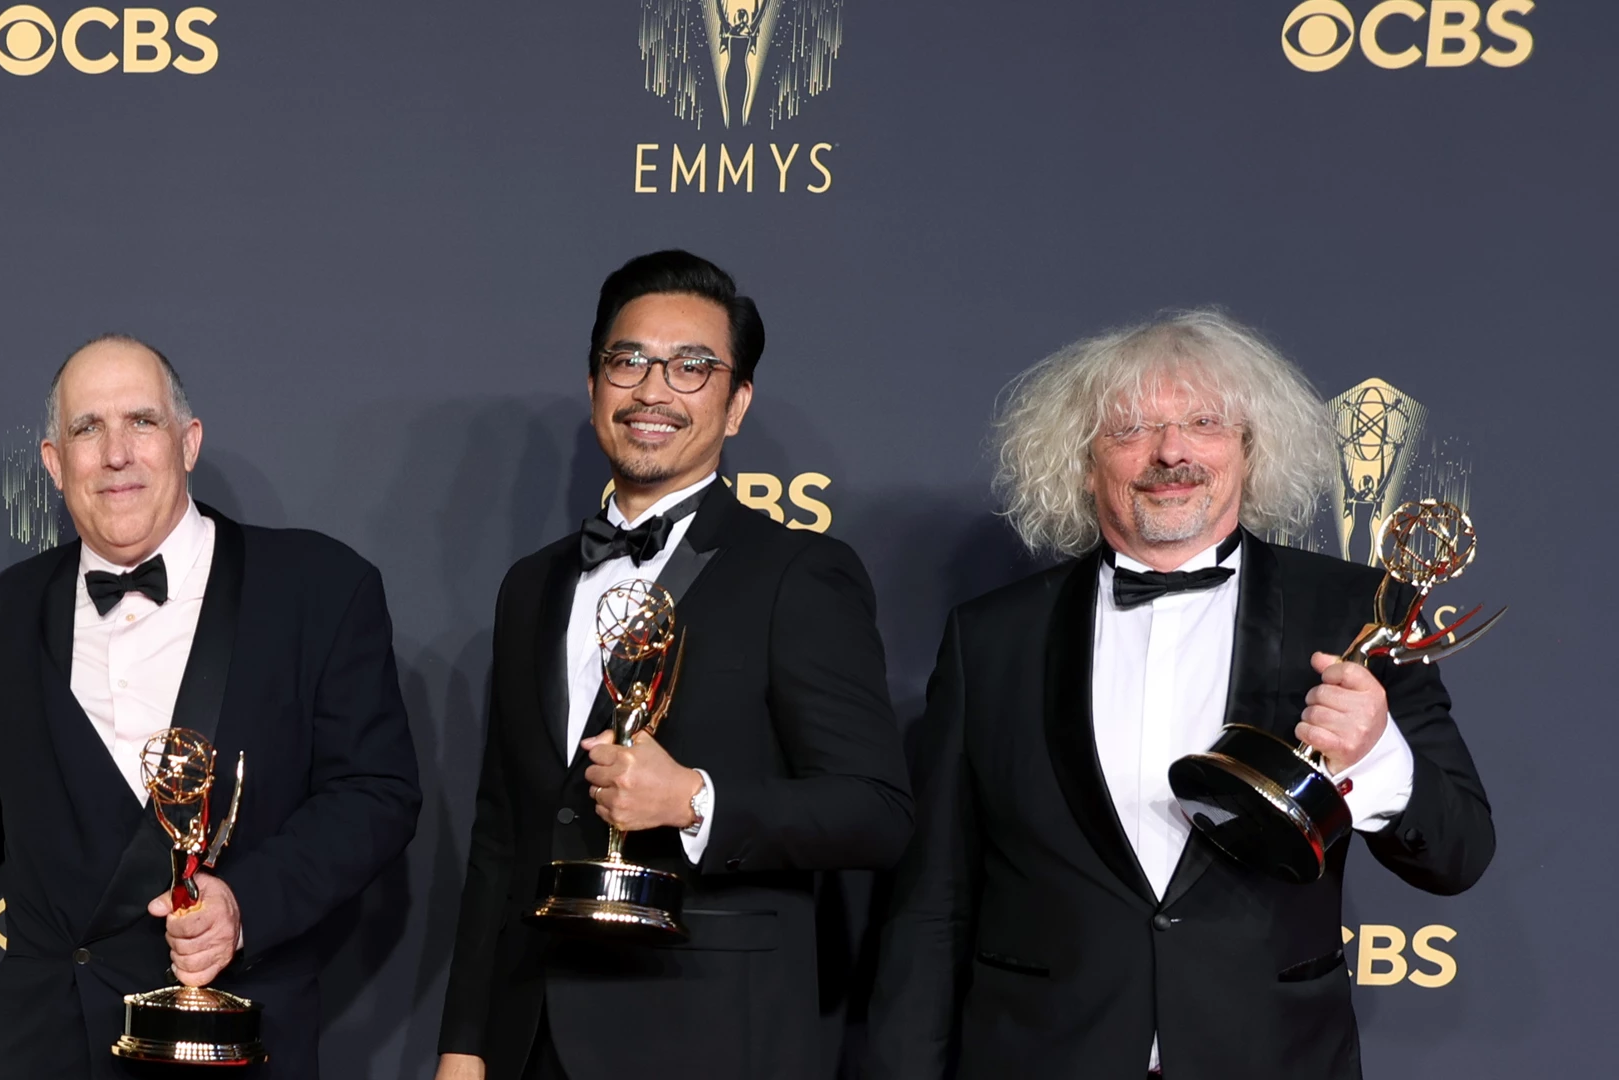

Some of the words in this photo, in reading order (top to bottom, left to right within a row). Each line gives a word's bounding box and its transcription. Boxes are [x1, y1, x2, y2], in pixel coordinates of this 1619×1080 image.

[61, 6, 219, 75] CBS
[1359, 0, 1536, 70] CBS
[634, 143, 833, 193] EMMYS
[721, 472, 833, 534] BS
[1340, 923, 1459, 989] BS
